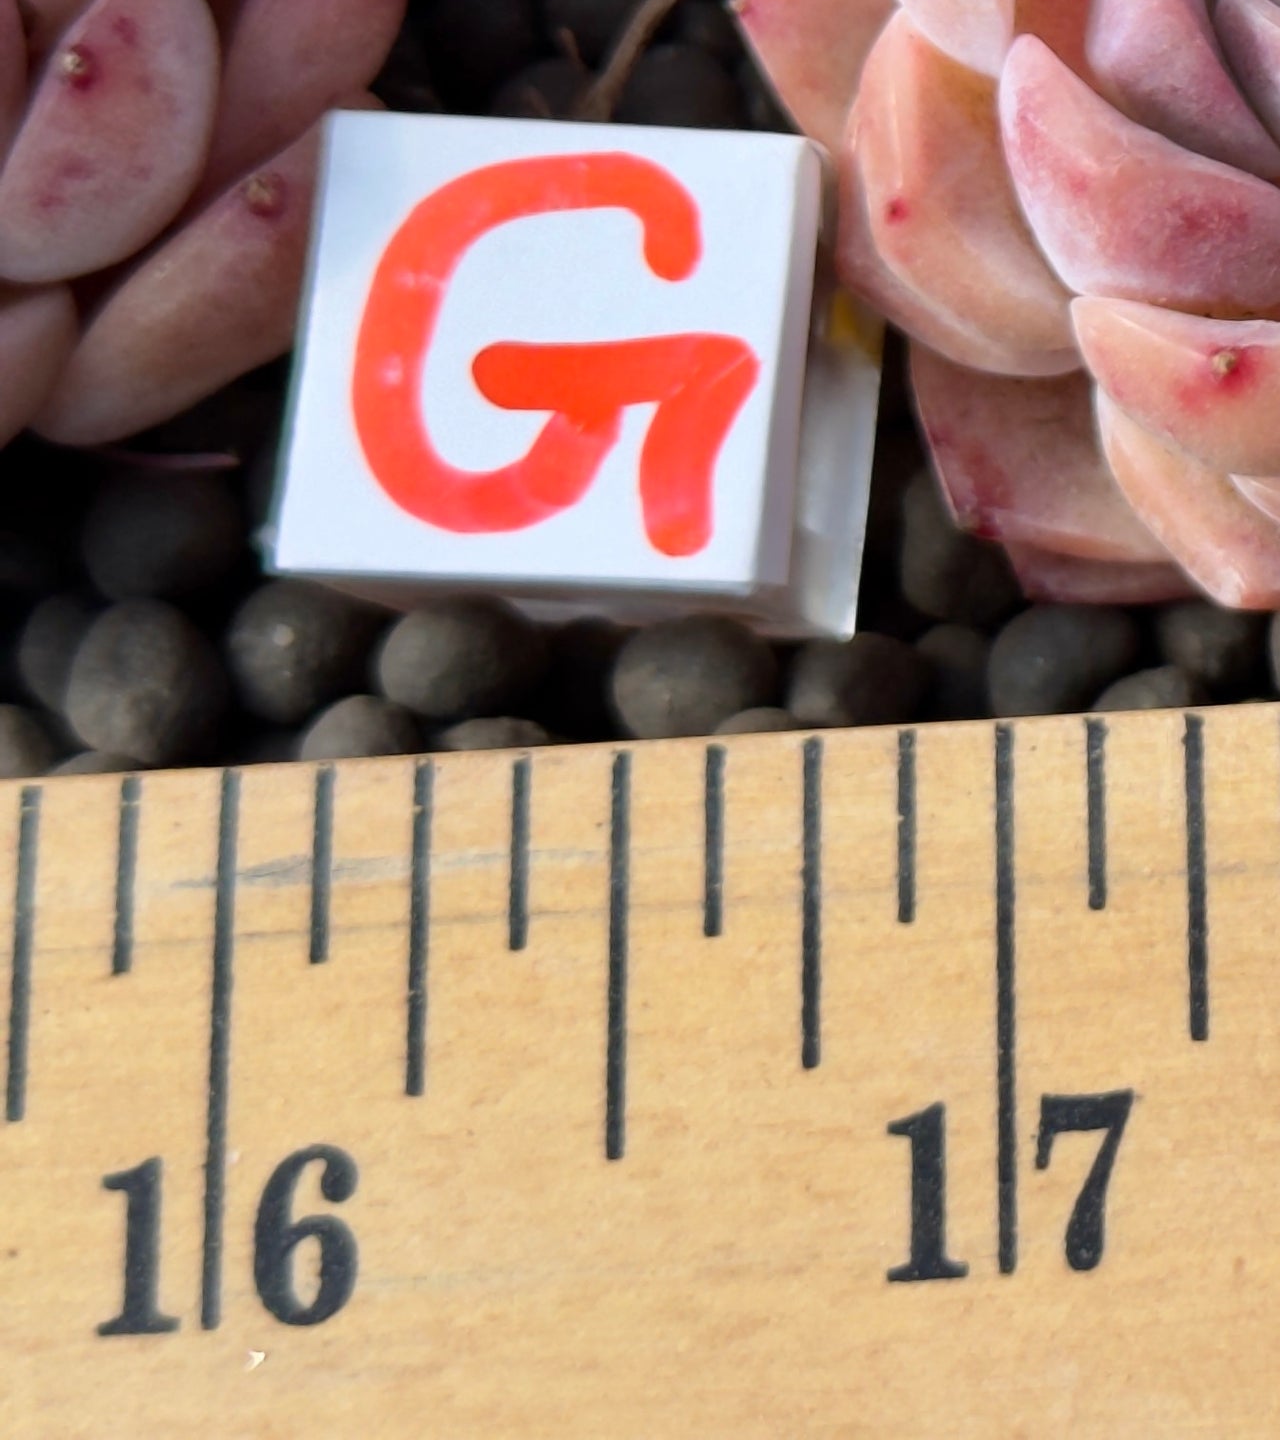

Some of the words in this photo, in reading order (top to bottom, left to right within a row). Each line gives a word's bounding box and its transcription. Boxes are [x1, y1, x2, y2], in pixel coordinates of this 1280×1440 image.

[350, 151, 761, 559] G
[97, 1143, 361, 1338] 16
[886, 1088, 1136, 1284] 17
